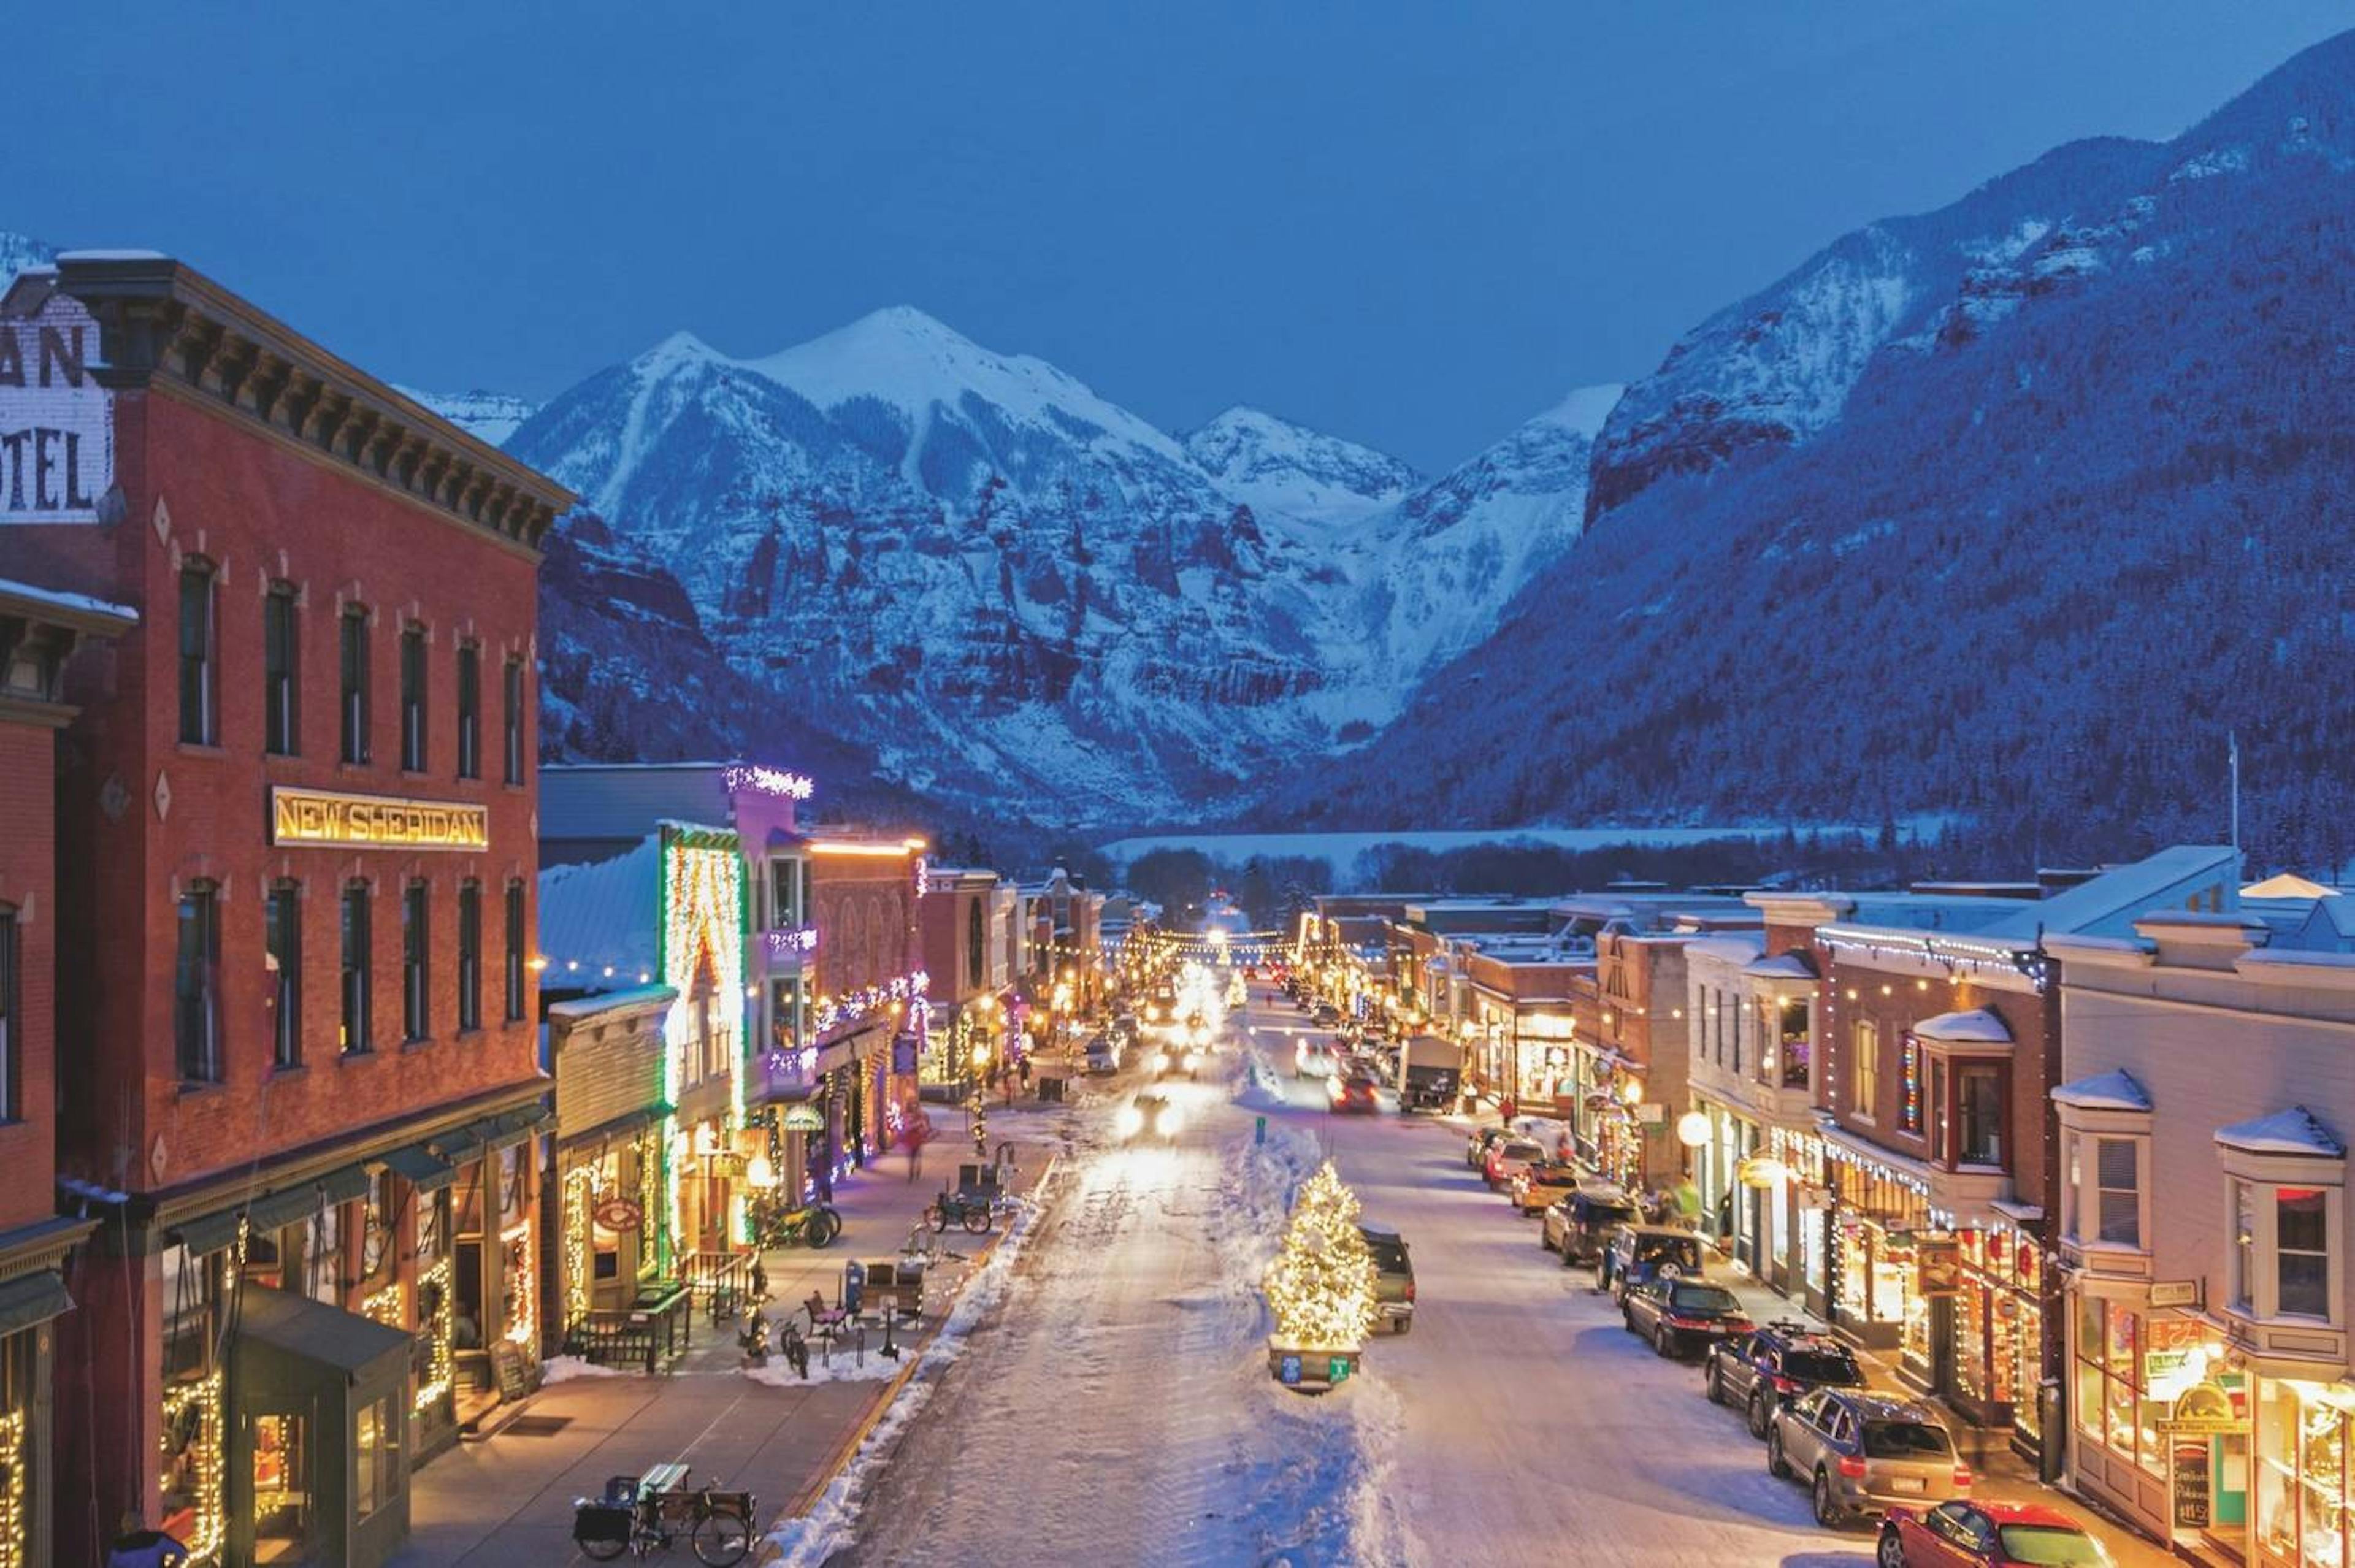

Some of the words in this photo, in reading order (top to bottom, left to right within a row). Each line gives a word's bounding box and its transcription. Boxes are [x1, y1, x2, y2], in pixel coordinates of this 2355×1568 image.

[0, 427, 93, 510] TEL
[277, 799, 341, 839] NEW
[349, 804, 480, 844] SHERIDAN
